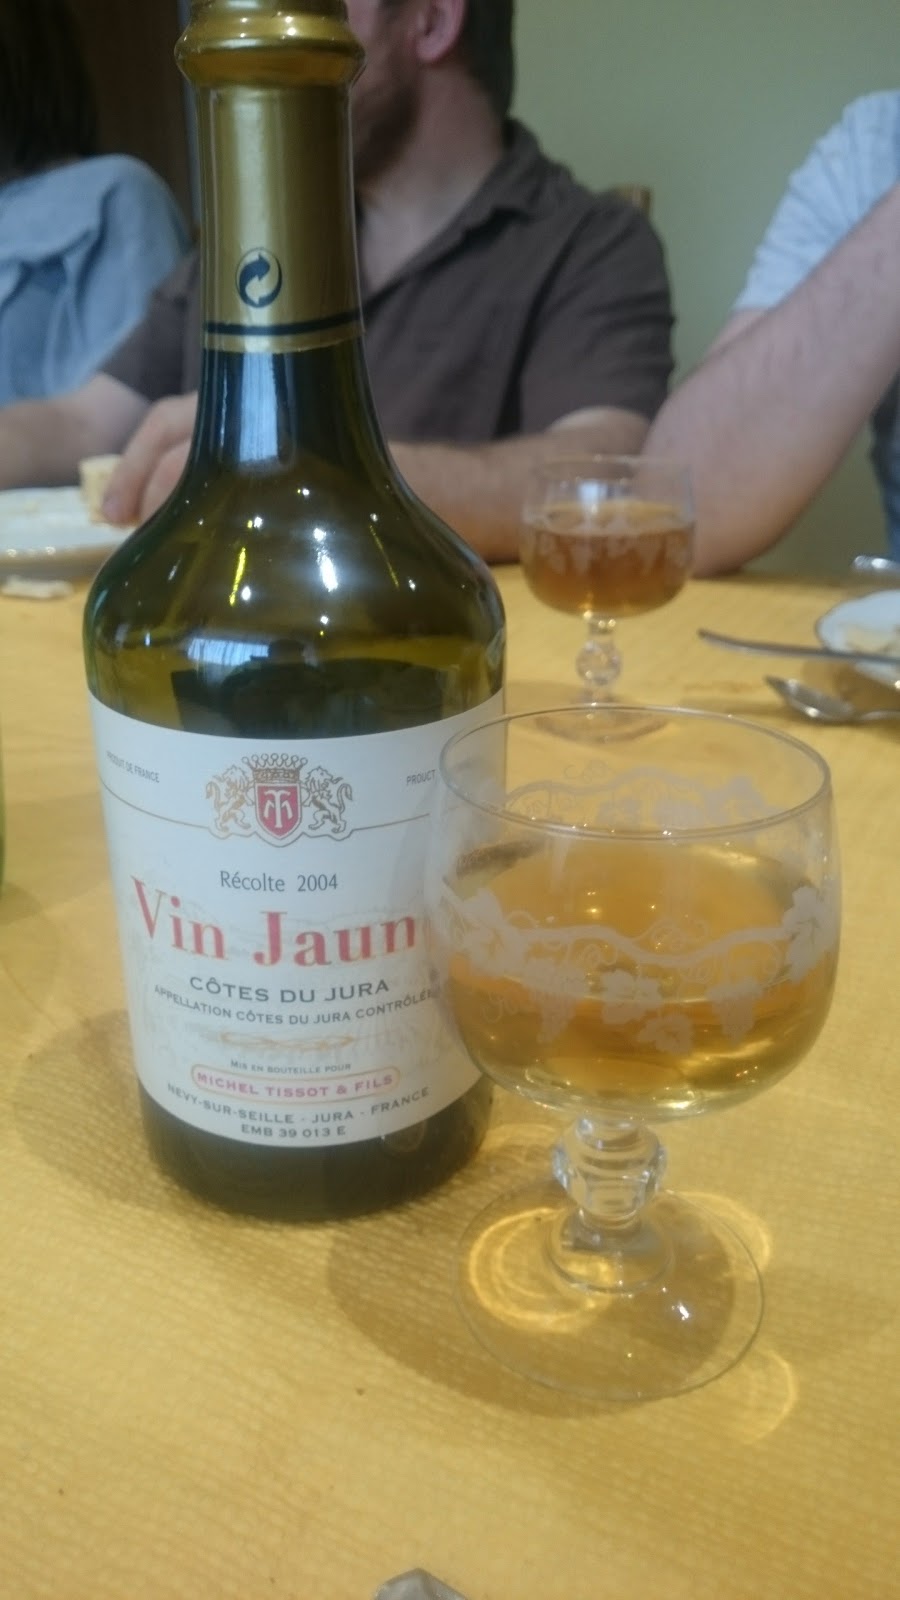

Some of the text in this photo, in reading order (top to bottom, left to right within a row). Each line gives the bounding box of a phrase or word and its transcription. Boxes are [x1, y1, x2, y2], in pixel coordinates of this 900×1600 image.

[220, 870, 338, 892] Récolte 2004
[130, 875, 416, 967] Vin Jaun
[189, 976, 389, 1003] CÔTES DU JURA
[154, 985, 231, 1018] APPELLATION
[236, 1010, 283, 1025] CÔTES
[289, 1014, 309, 1025] DU
[313, 1012, 351, 1024] JURA
[267, 1066, 321, 1075] BOUTEILLE
[324, 1063, 351, 1073] POUR
[197, 1072, 393, 1098] MICHEL TISSOT & FILS
[167, 1083, 295, 1124] NEVY-SUR-SEILLE
[311, 1110, 354, 1124] JURA
[371, 1086, 430, 1116] FRANCE
[241, 1124, 347, 1138] EMB 39 013 E
